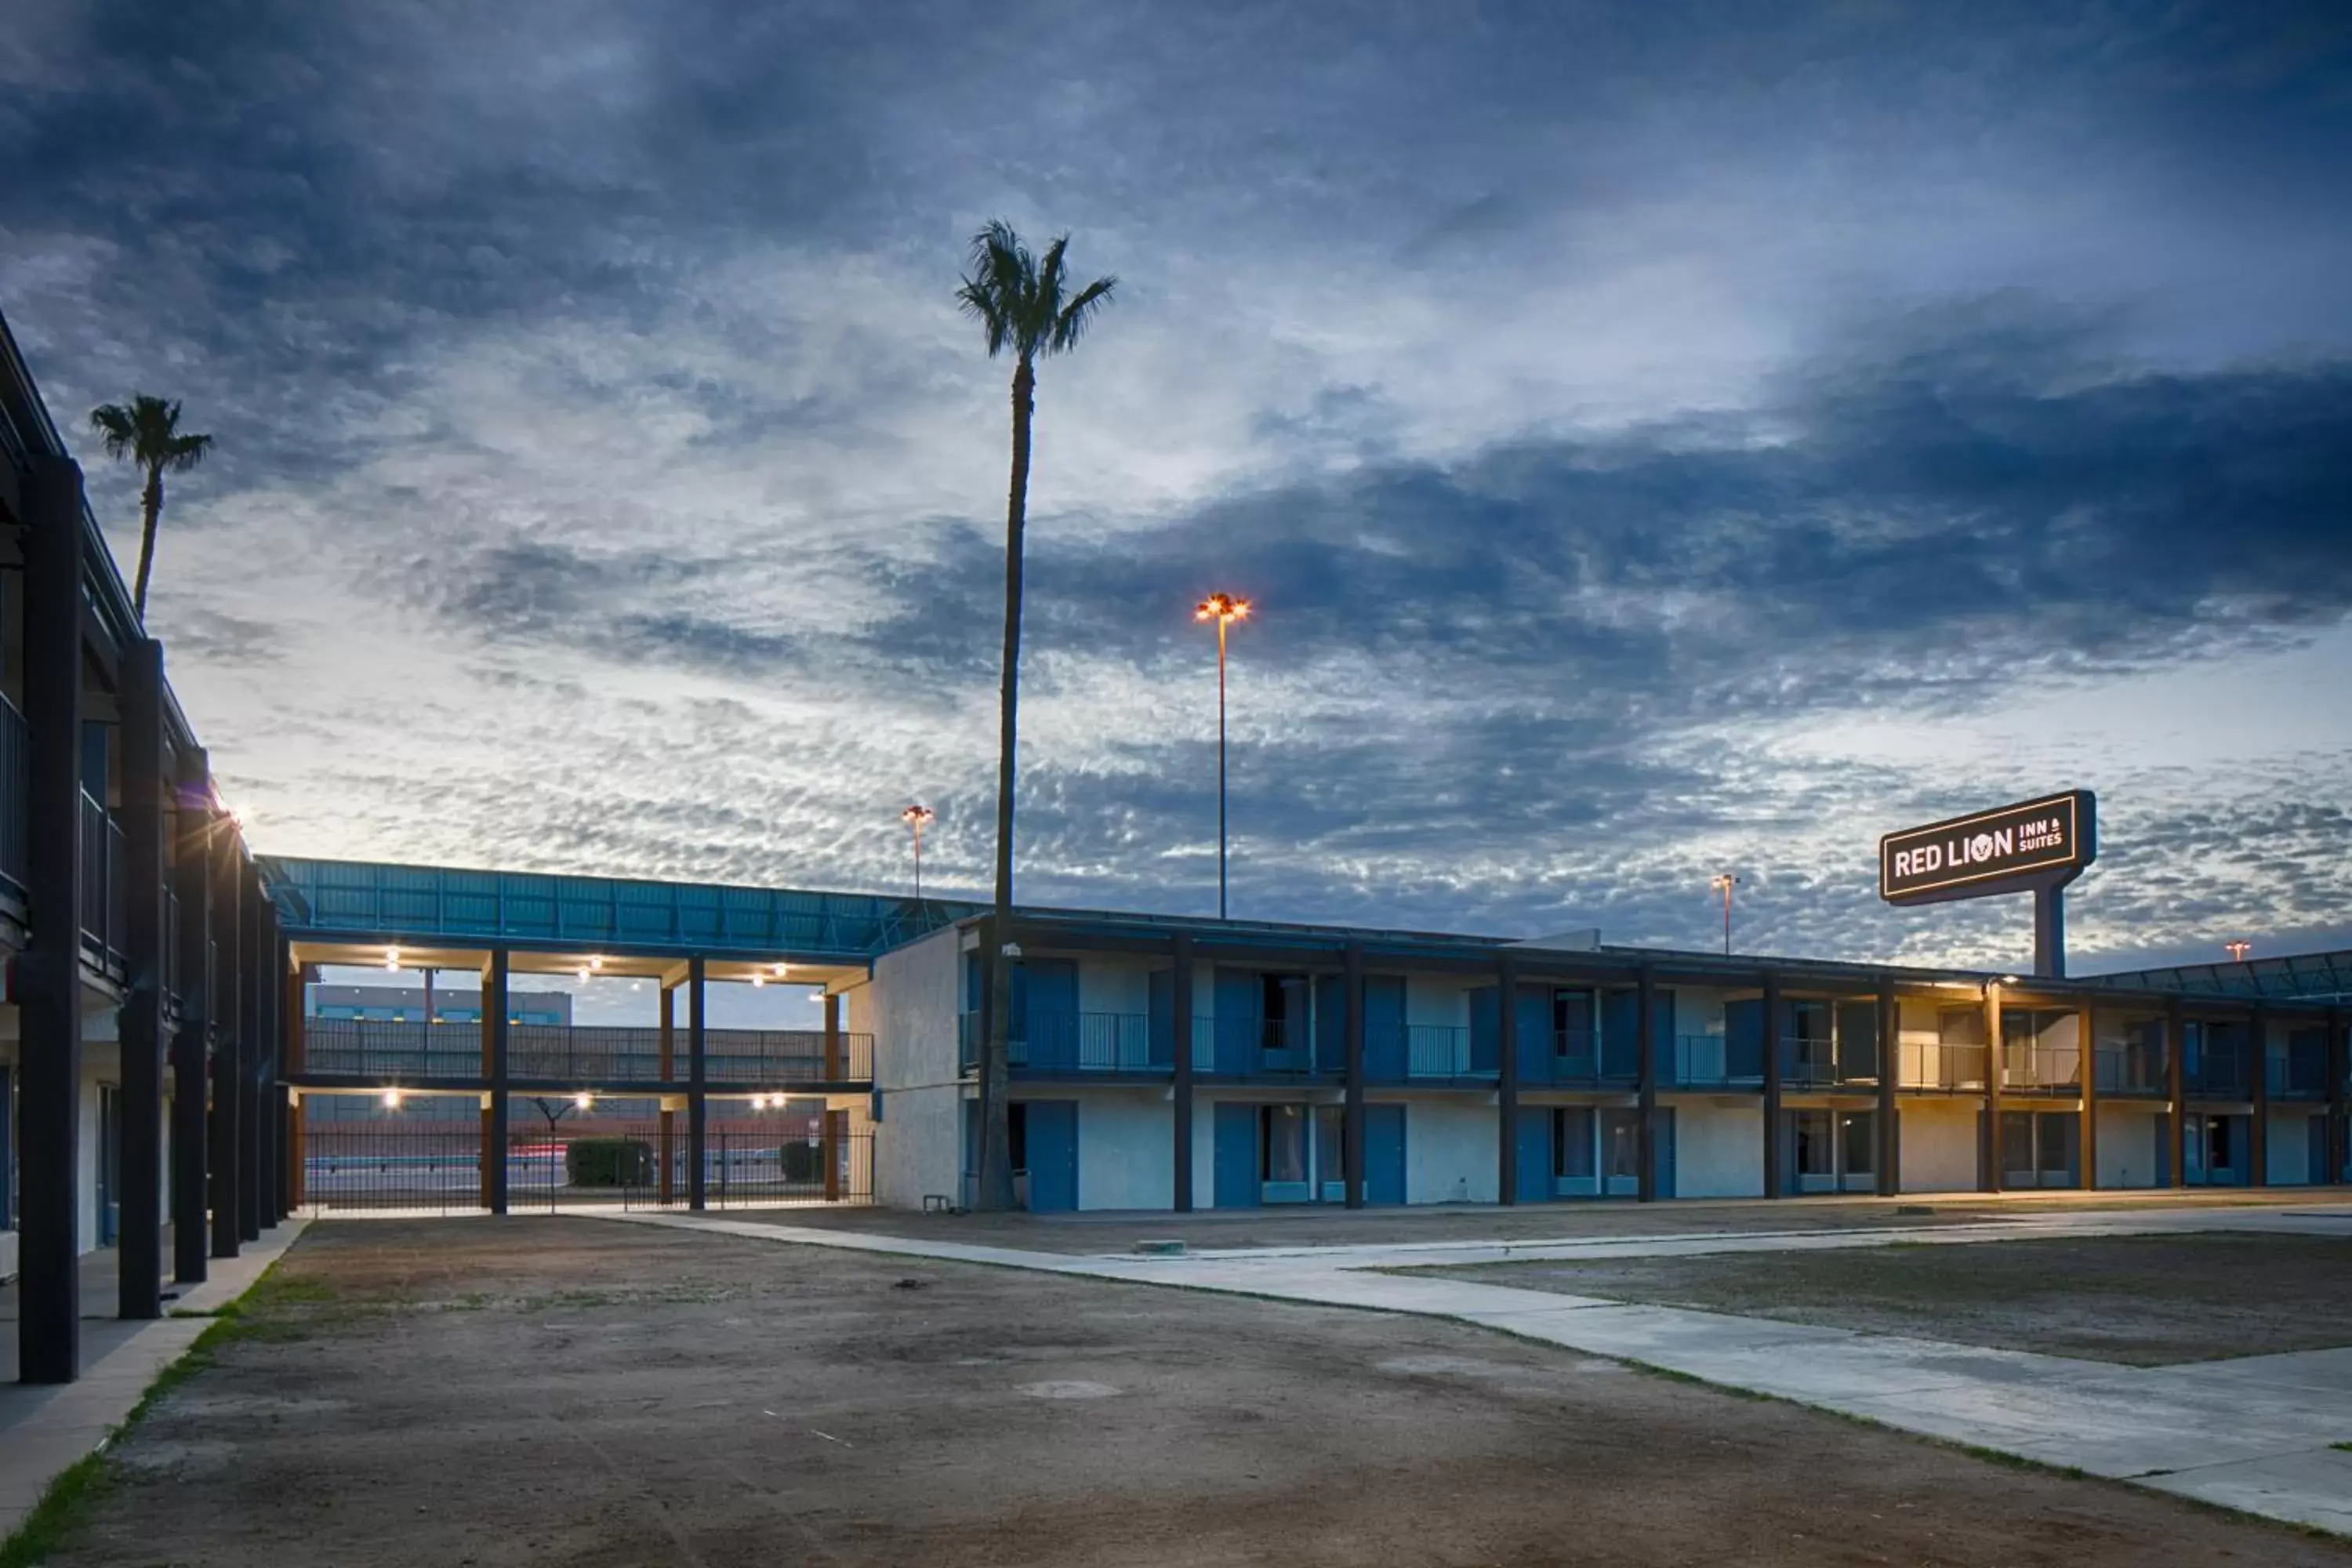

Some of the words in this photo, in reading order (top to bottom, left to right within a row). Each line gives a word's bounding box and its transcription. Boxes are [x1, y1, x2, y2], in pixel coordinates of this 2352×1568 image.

[2019, 819, 2047, 838] INN
[2019, 833, 2063, 852] SUITES
[1895, 844, 1941, 877] RED
[1948, 828, 2012, 866] LION
